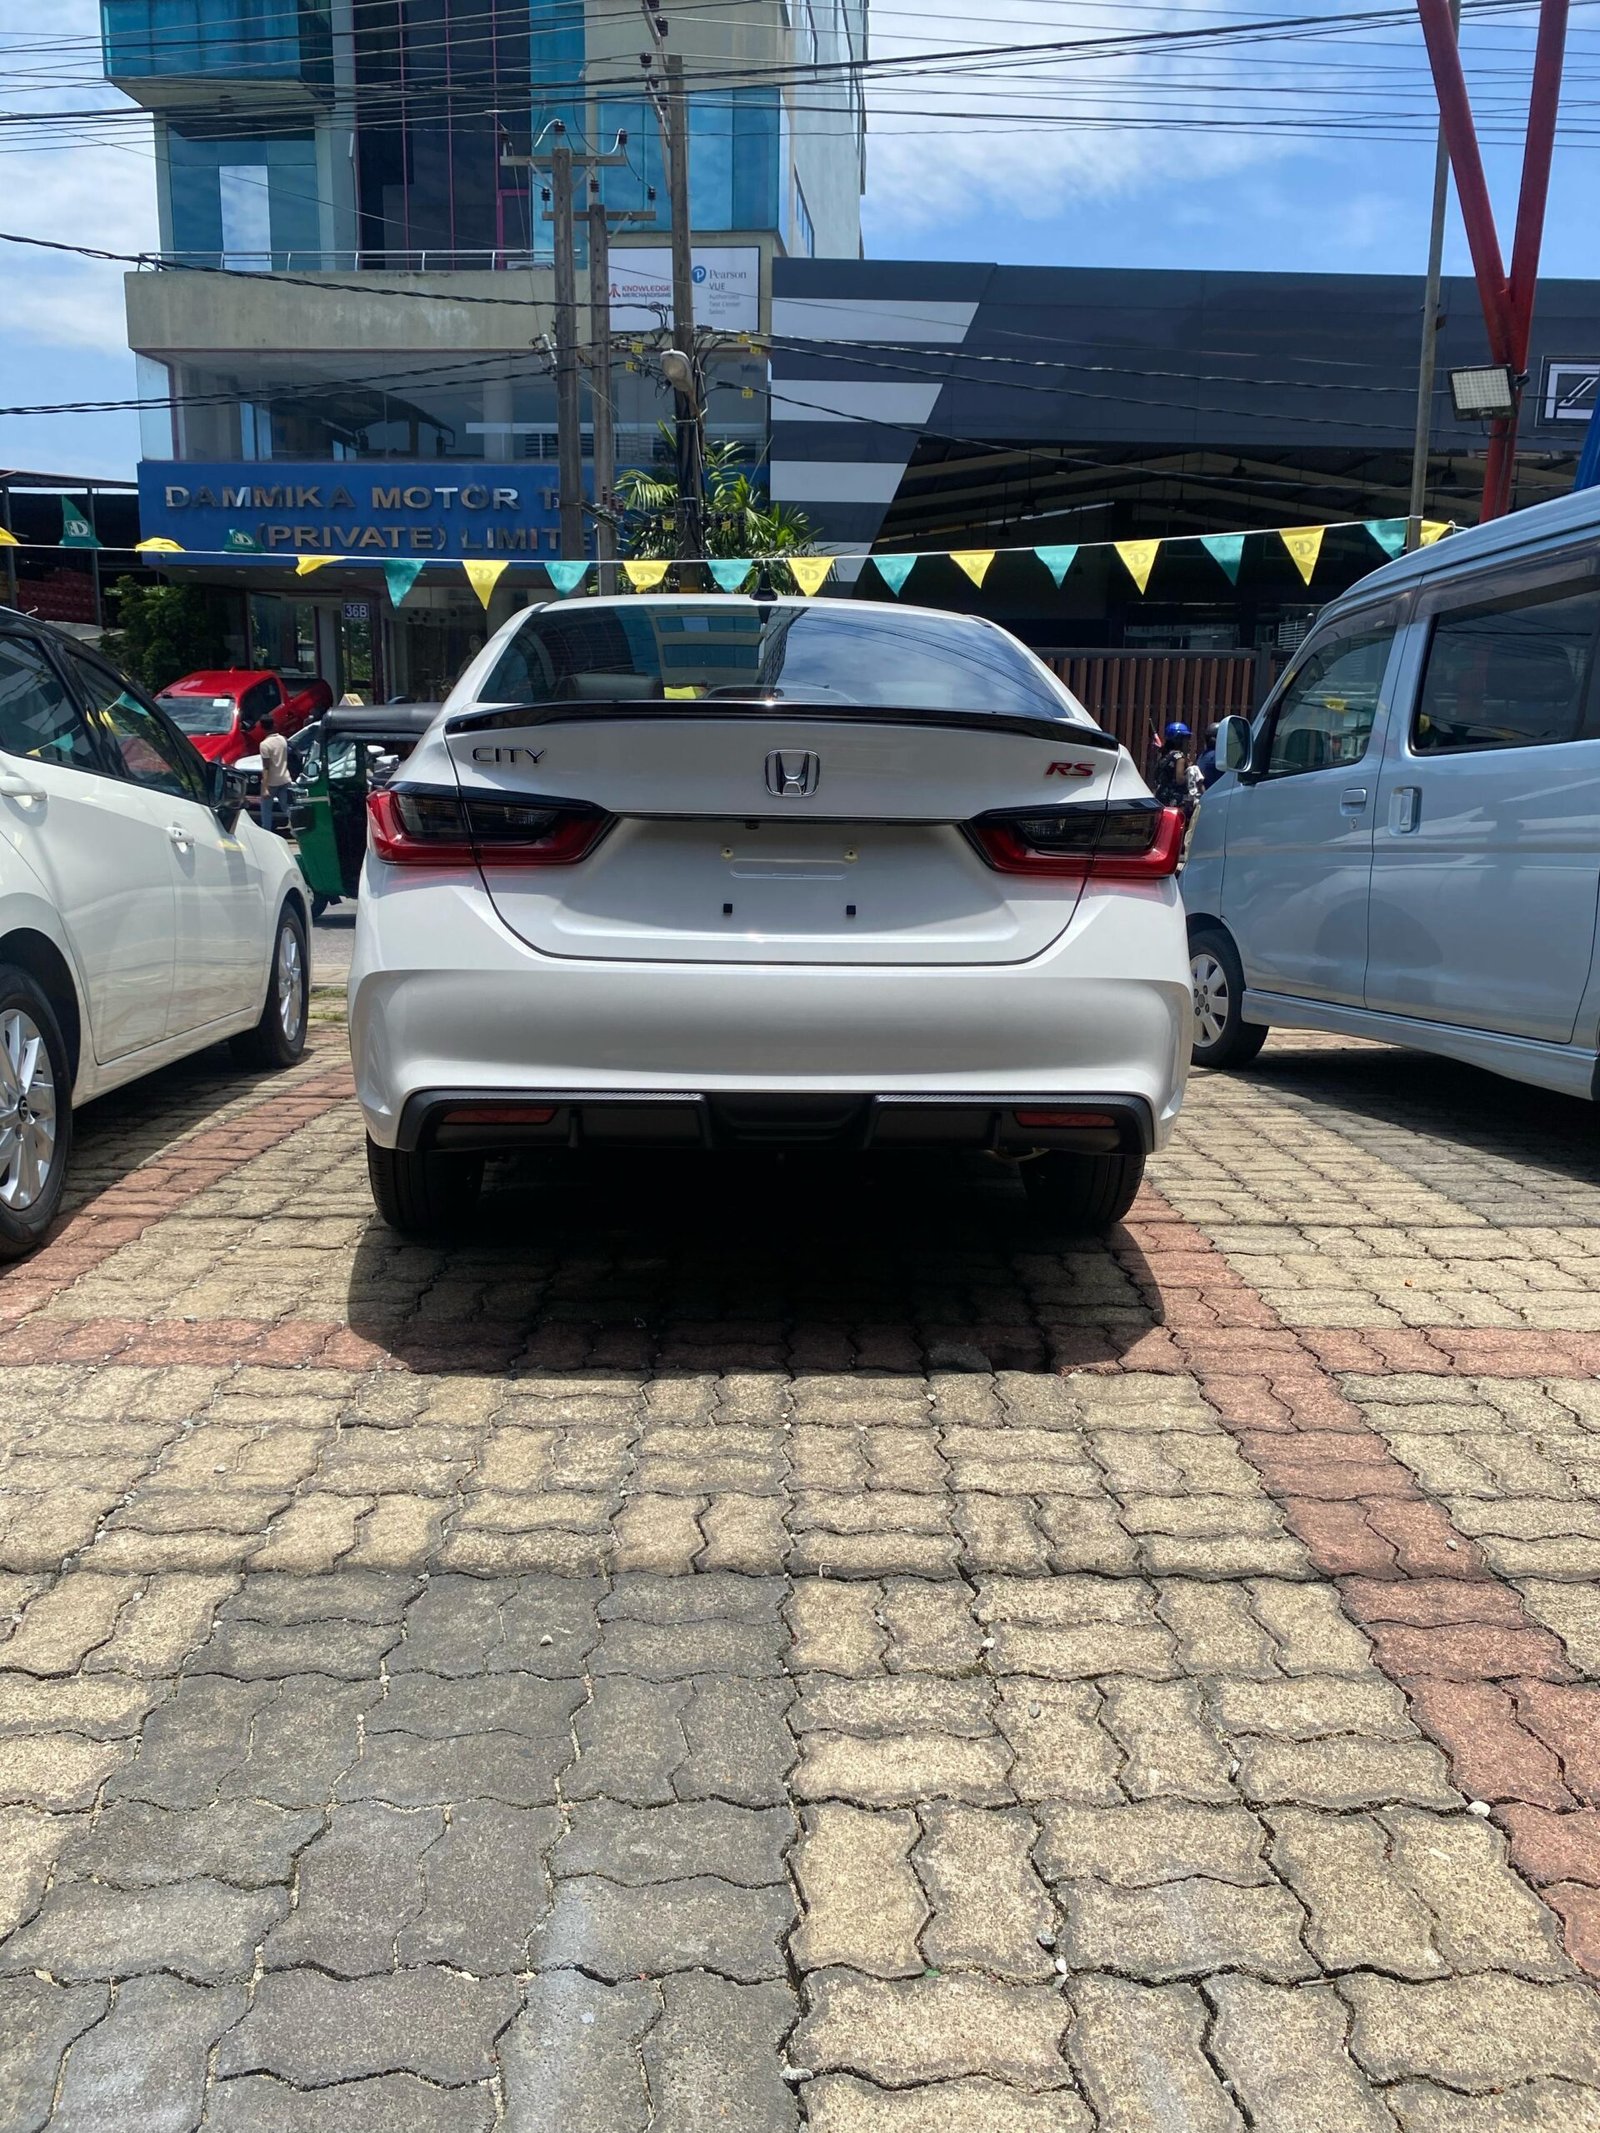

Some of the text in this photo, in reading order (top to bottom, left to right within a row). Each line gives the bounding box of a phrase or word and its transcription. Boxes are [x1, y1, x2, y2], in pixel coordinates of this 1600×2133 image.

[709, 269, 747, 280] Pearson
[709, 282, 725, 290] VUE
[164, 485, 356, 509] DAMMIKA
[371, 486, 521, 510] MOTOR
[255, 522, 447, 550] (PRIVATE)
[460, 526, 620, 550] LIMITE
[346, 605, 367, 617] 36B
[471, 747, 546, 764] CITY
[1045, 762, 1097, 777] RS
